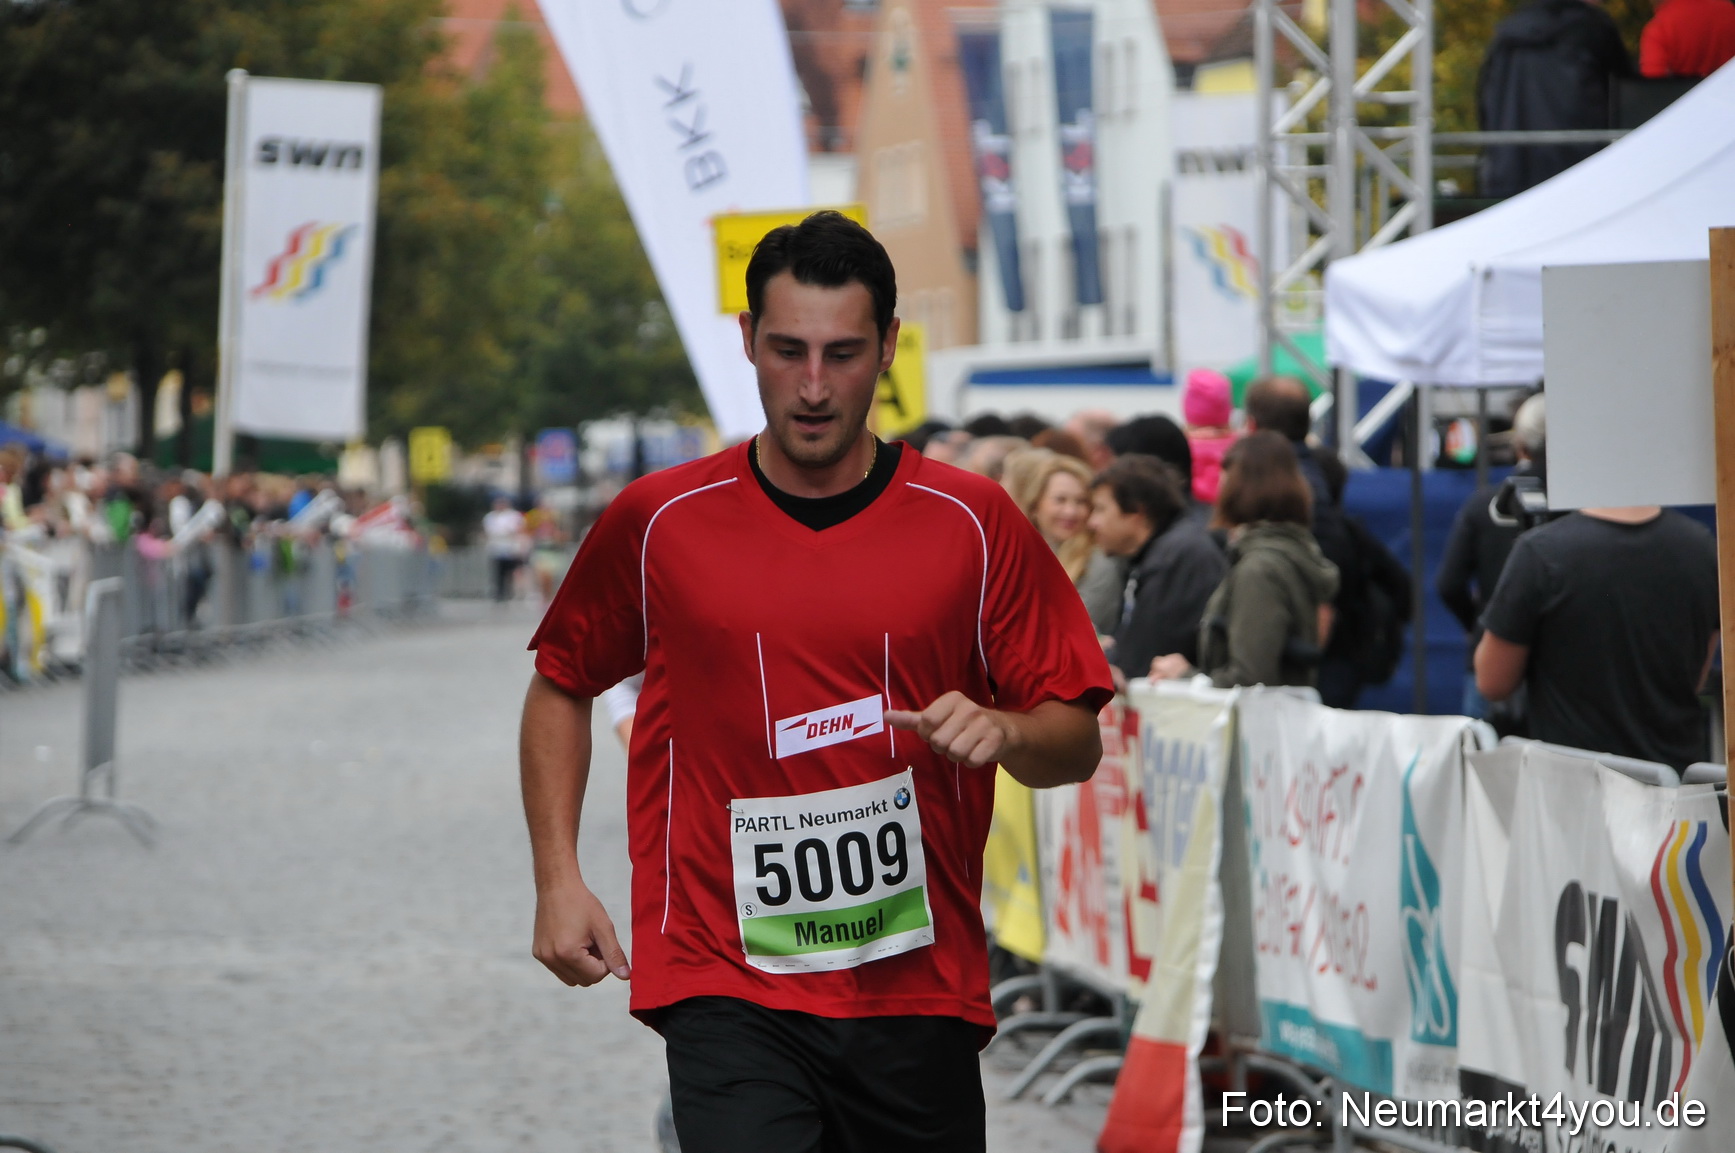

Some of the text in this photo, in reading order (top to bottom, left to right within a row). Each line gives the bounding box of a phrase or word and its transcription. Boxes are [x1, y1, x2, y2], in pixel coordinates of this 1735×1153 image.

[655, 59, 729, 193] BKK
[806, 713, 854, 739] DEHN
[735, 799, 888, 833] PARTL Neumarkt
[754, 821, 908, 906] 5009
[795, 908, 883, 946] Manuel
